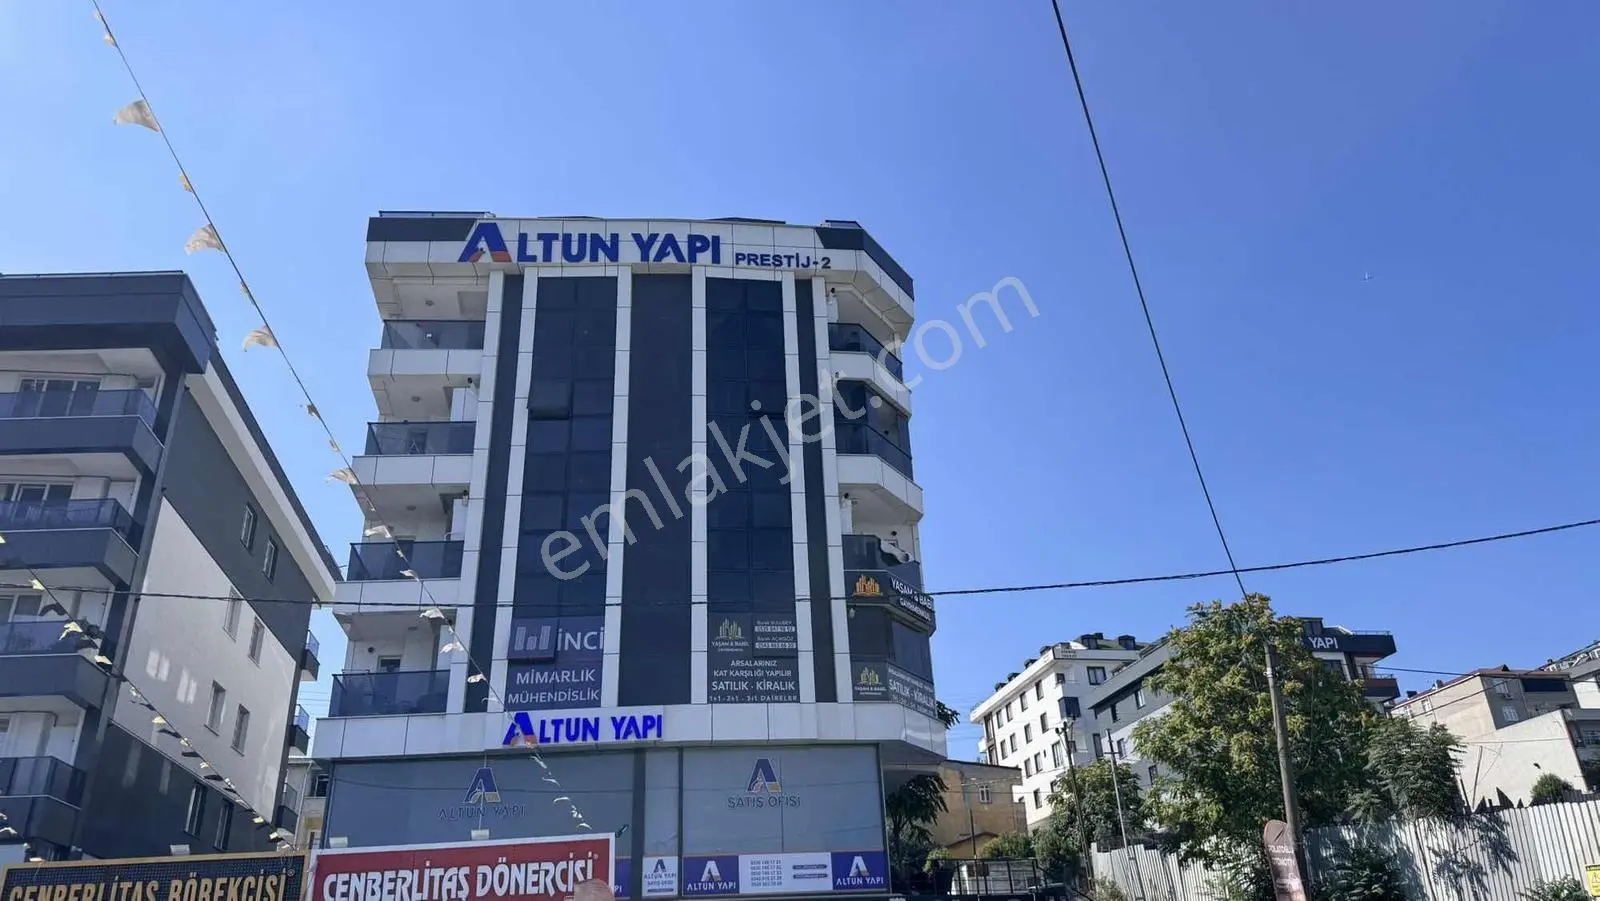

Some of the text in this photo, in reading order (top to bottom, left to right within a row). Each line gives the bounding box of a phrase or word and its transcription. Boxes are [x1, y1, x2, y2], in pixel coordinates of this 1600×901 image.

[458, 222, 620, 263] ALTUN
[631, 232, 721, 264] YAPI
[1308, 636, 1339, 649] YAPI
[516, 668, 596, 685] MİMARLIK
[713, 669, 728, 677] KAT
[711, 681, 749, 691] SATILIK
[756, 678, 796, 691] KİRALIK
[507, 687, 600, 704] MÜHENDİSLİK
[503, 711, 663, 746] ALTUN YAPI
[493, 803, 527, 817] YAPI
[686, 881, 737, 892] ALTUN YAPI
[836, 876, 864, 886] ALTUN
[865, 876, 885, 885] YAPI
